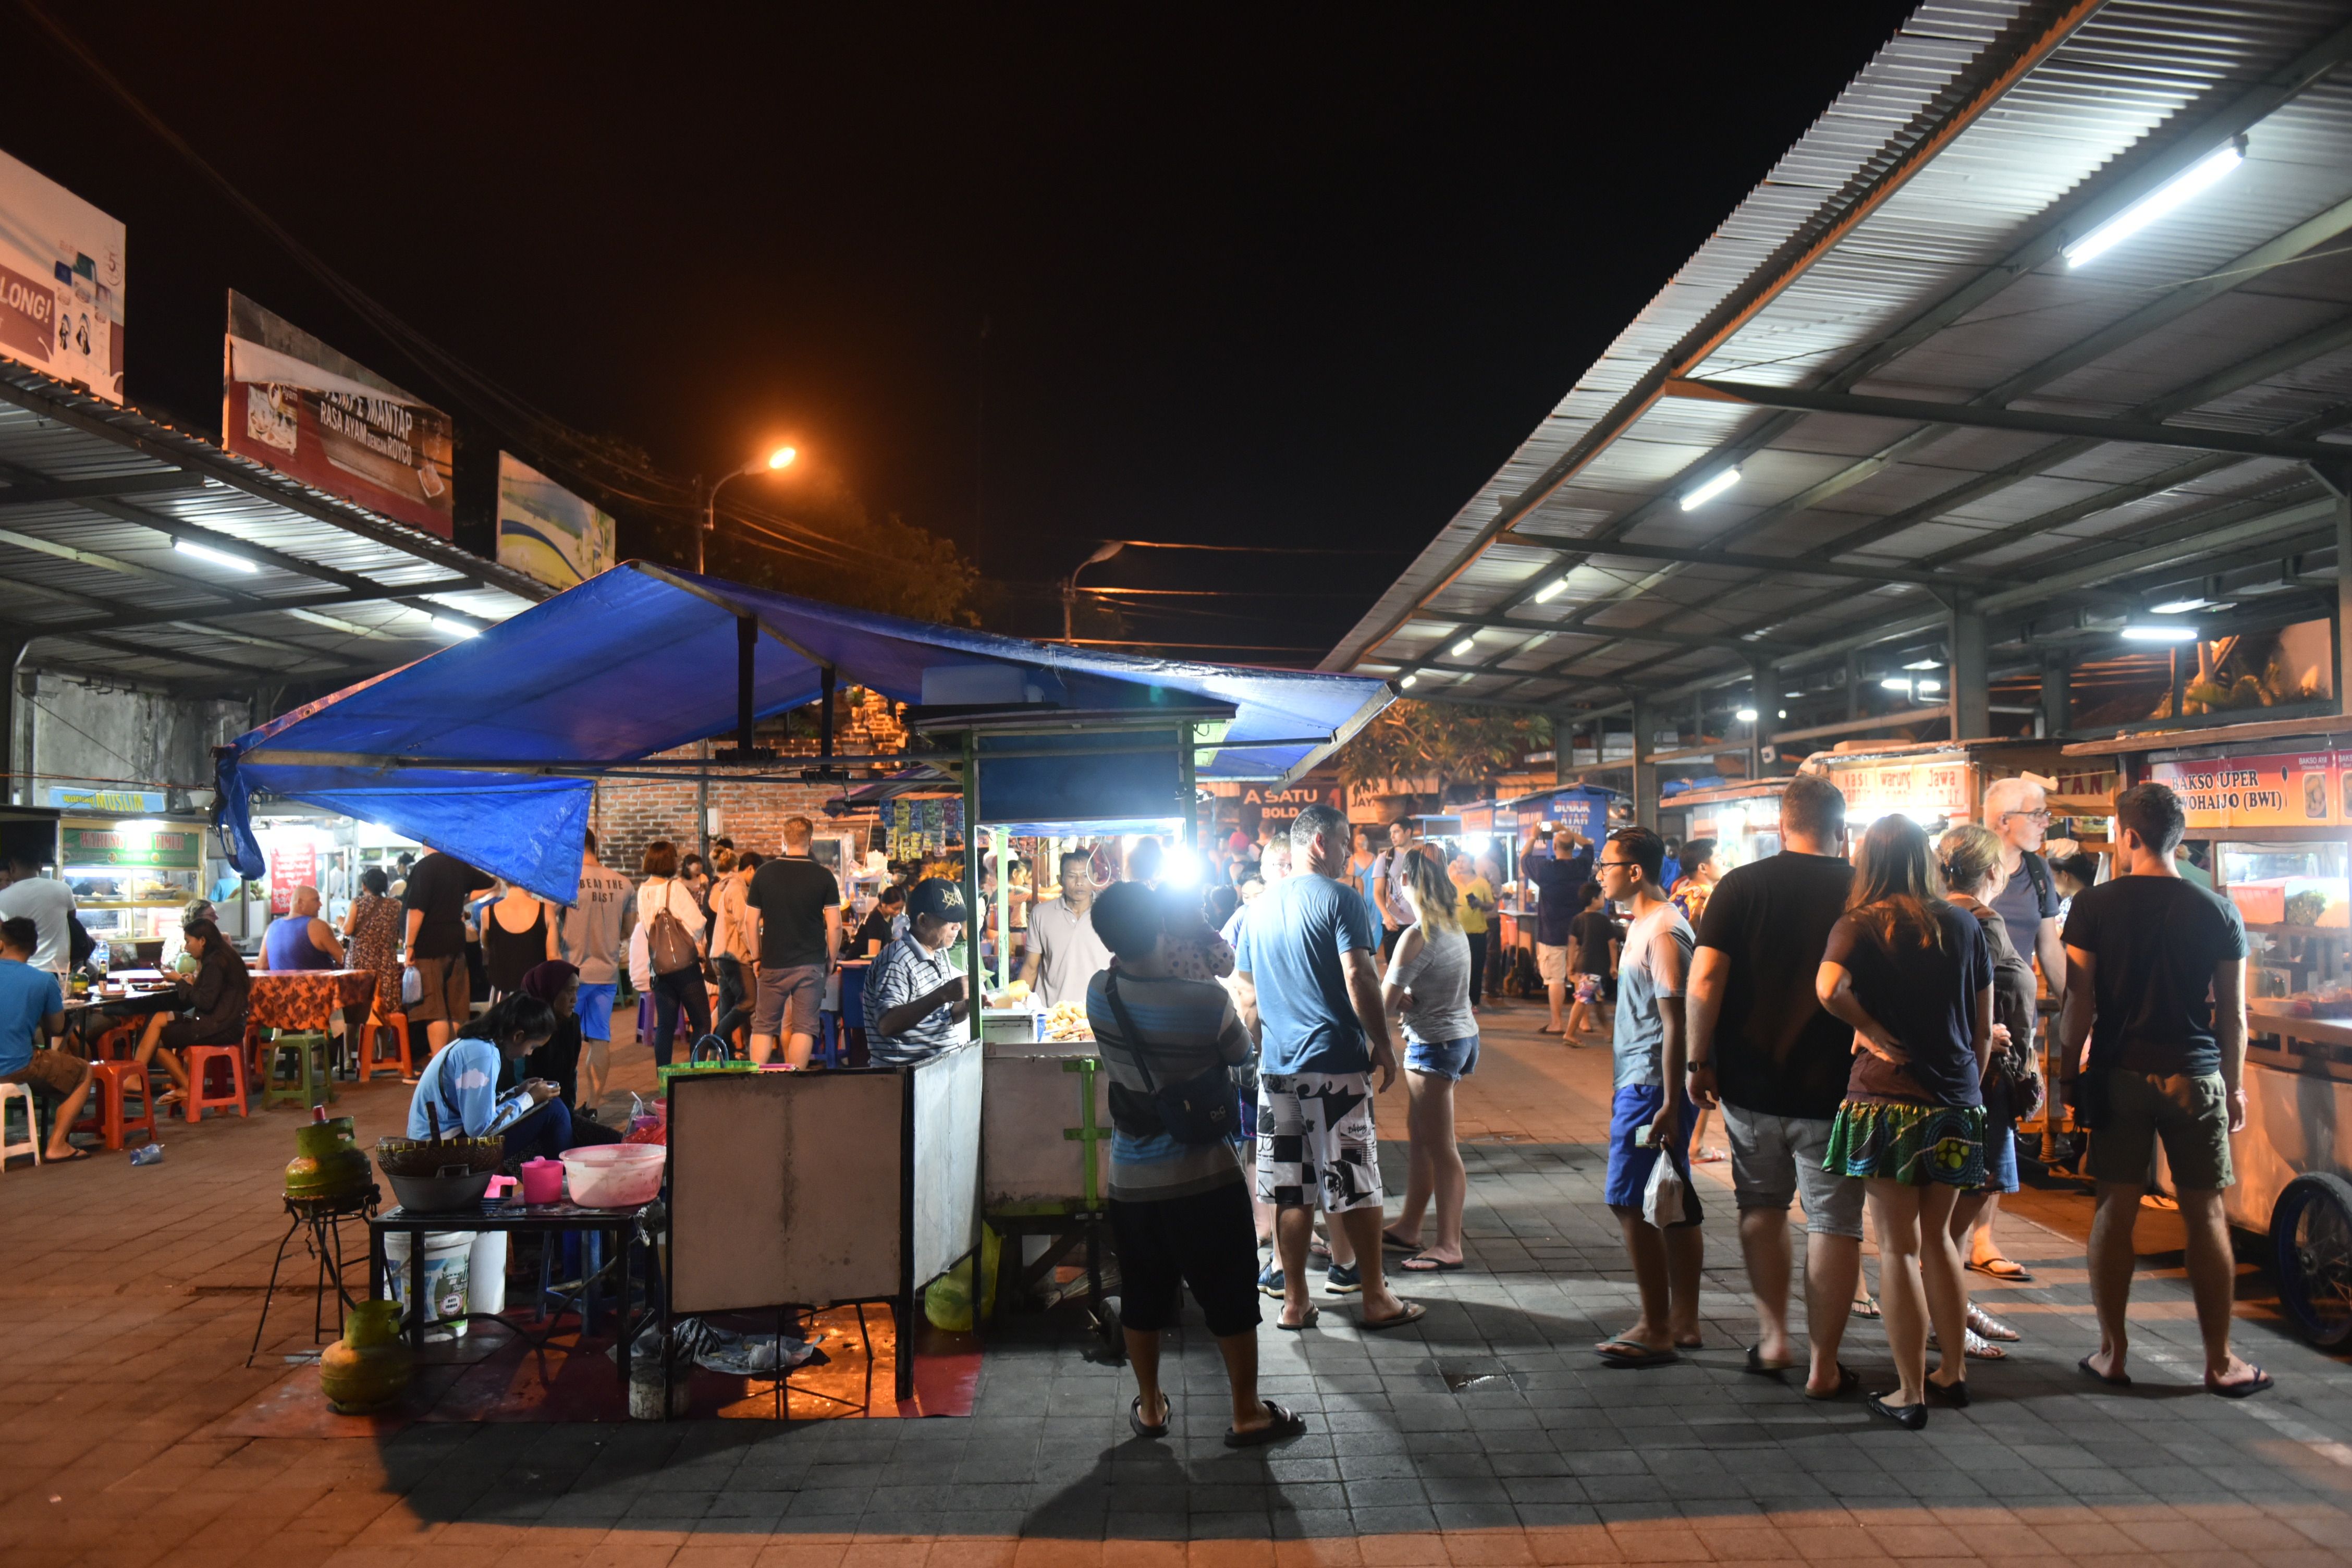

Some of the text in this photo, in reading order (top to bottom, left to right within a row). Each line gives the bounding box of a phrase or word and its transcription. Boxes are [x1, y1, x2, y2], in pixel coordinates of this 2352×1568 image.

[282, 385, 298, 401] Ayam
[367, 399, 413, 441] MANTAP
[320, 401, 412, 467] RASA AYAM DENGAN ROYCO
[1928, 768, 1955, 787] Jawa
[2172, 774, 2213, 790] BAKSO
[95, 792, 145, 813] MUSLIM
[1244, 789, 1318, 805] A SATU
[1351, 797, 1375, 807] JAY
[2244, 791, 2282, 811] (BWI)
[1261, 807, 1300, 818] BOLD
[80, 832, 124, 849] WARUNG
[155, 835, 185, 851] TIMUR
[606, 879, 623, 890] THE
